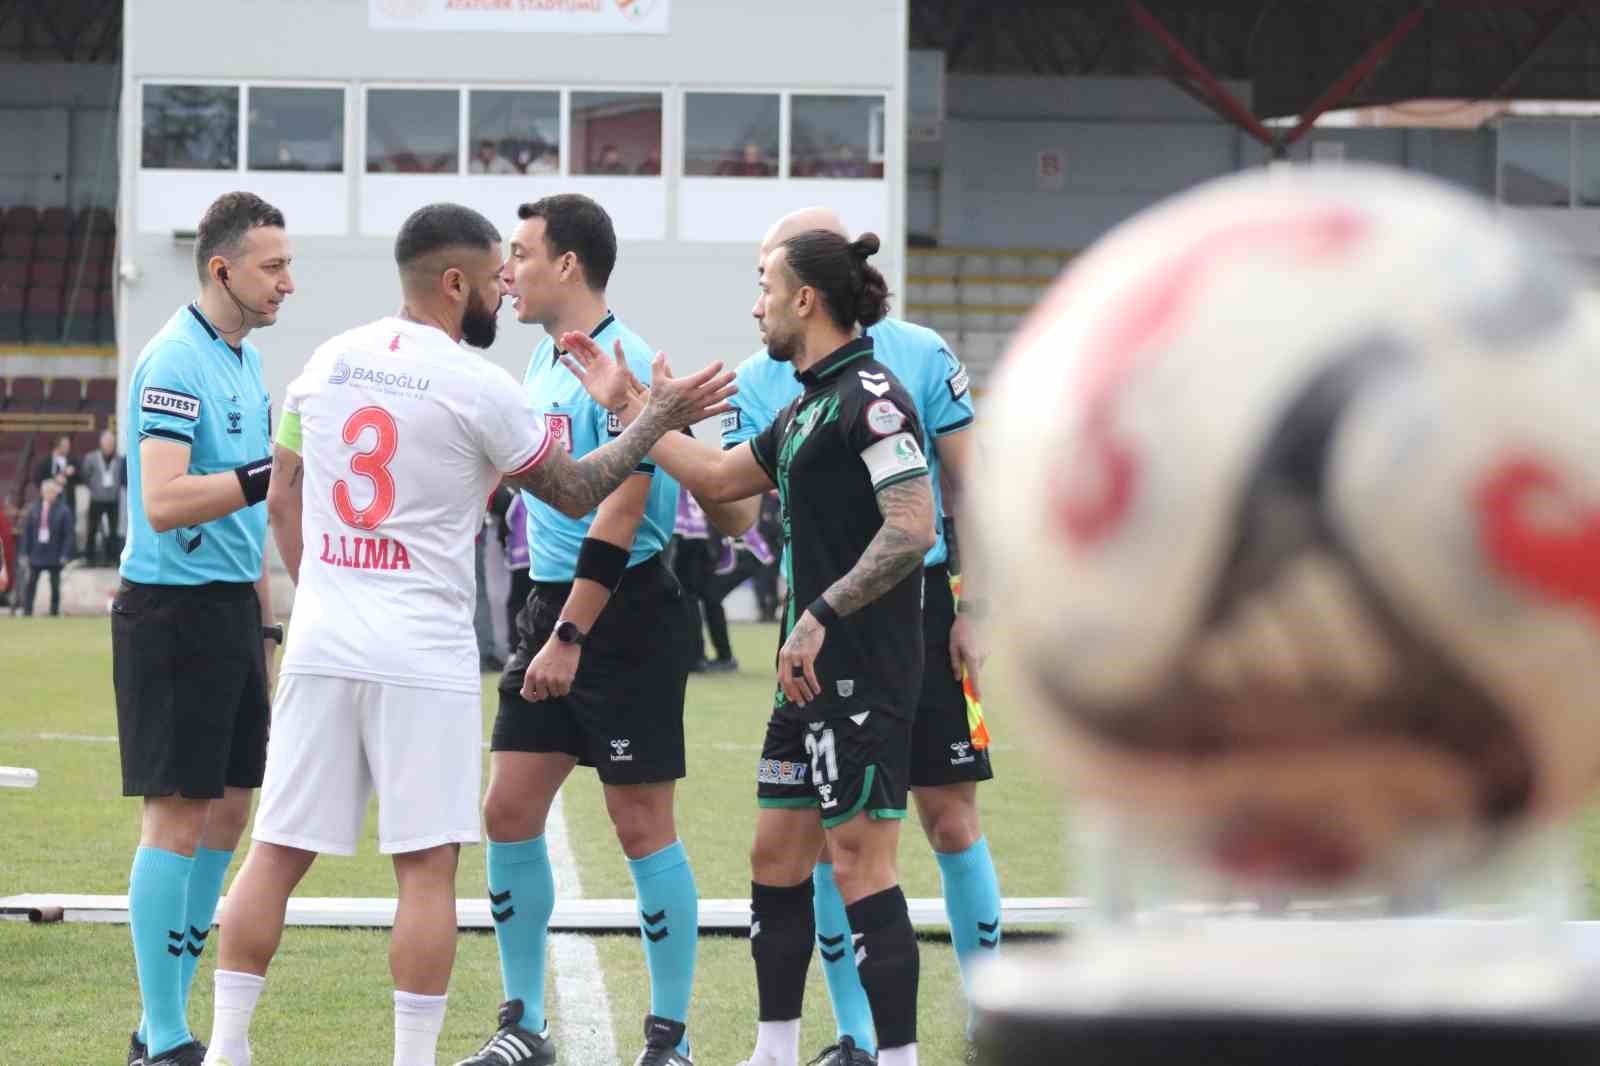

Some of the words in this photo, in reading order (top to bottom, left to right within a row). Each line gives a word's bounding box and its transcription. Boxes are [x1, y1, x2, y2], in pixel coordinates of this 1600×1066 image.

[147, 394, 196, 412] SZUTEST
[333, 406, 398, 531] 3
[320, 533, 411, 570] L.LIMA
[805, 729, 839, 785] 21
